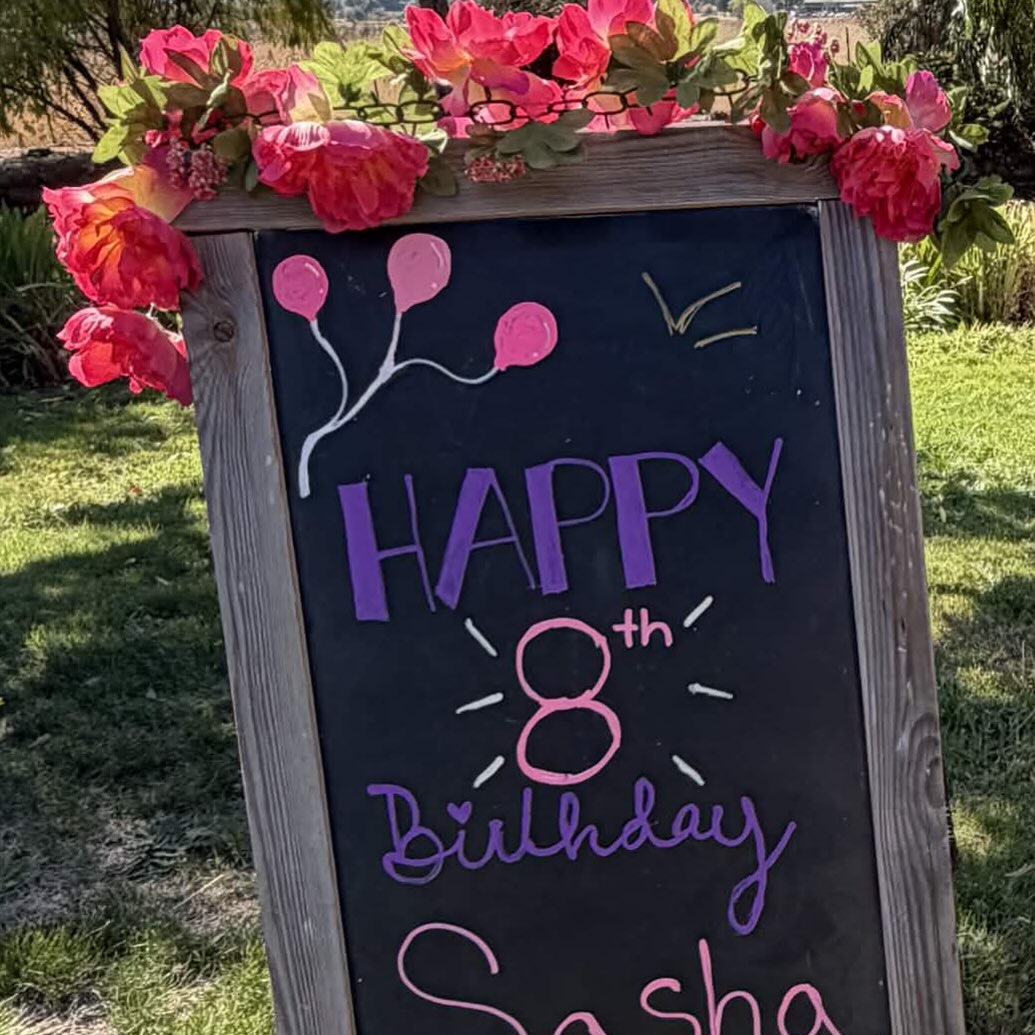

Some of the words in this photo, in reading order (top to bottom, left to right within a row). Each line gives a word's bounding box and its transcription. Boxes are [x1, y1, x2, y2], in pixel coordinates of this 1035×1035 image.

[337, 437, 784, 622] HAPPY
[515, 608, 674, 786] 8th
[366, 777, 797, 936] Birthday
